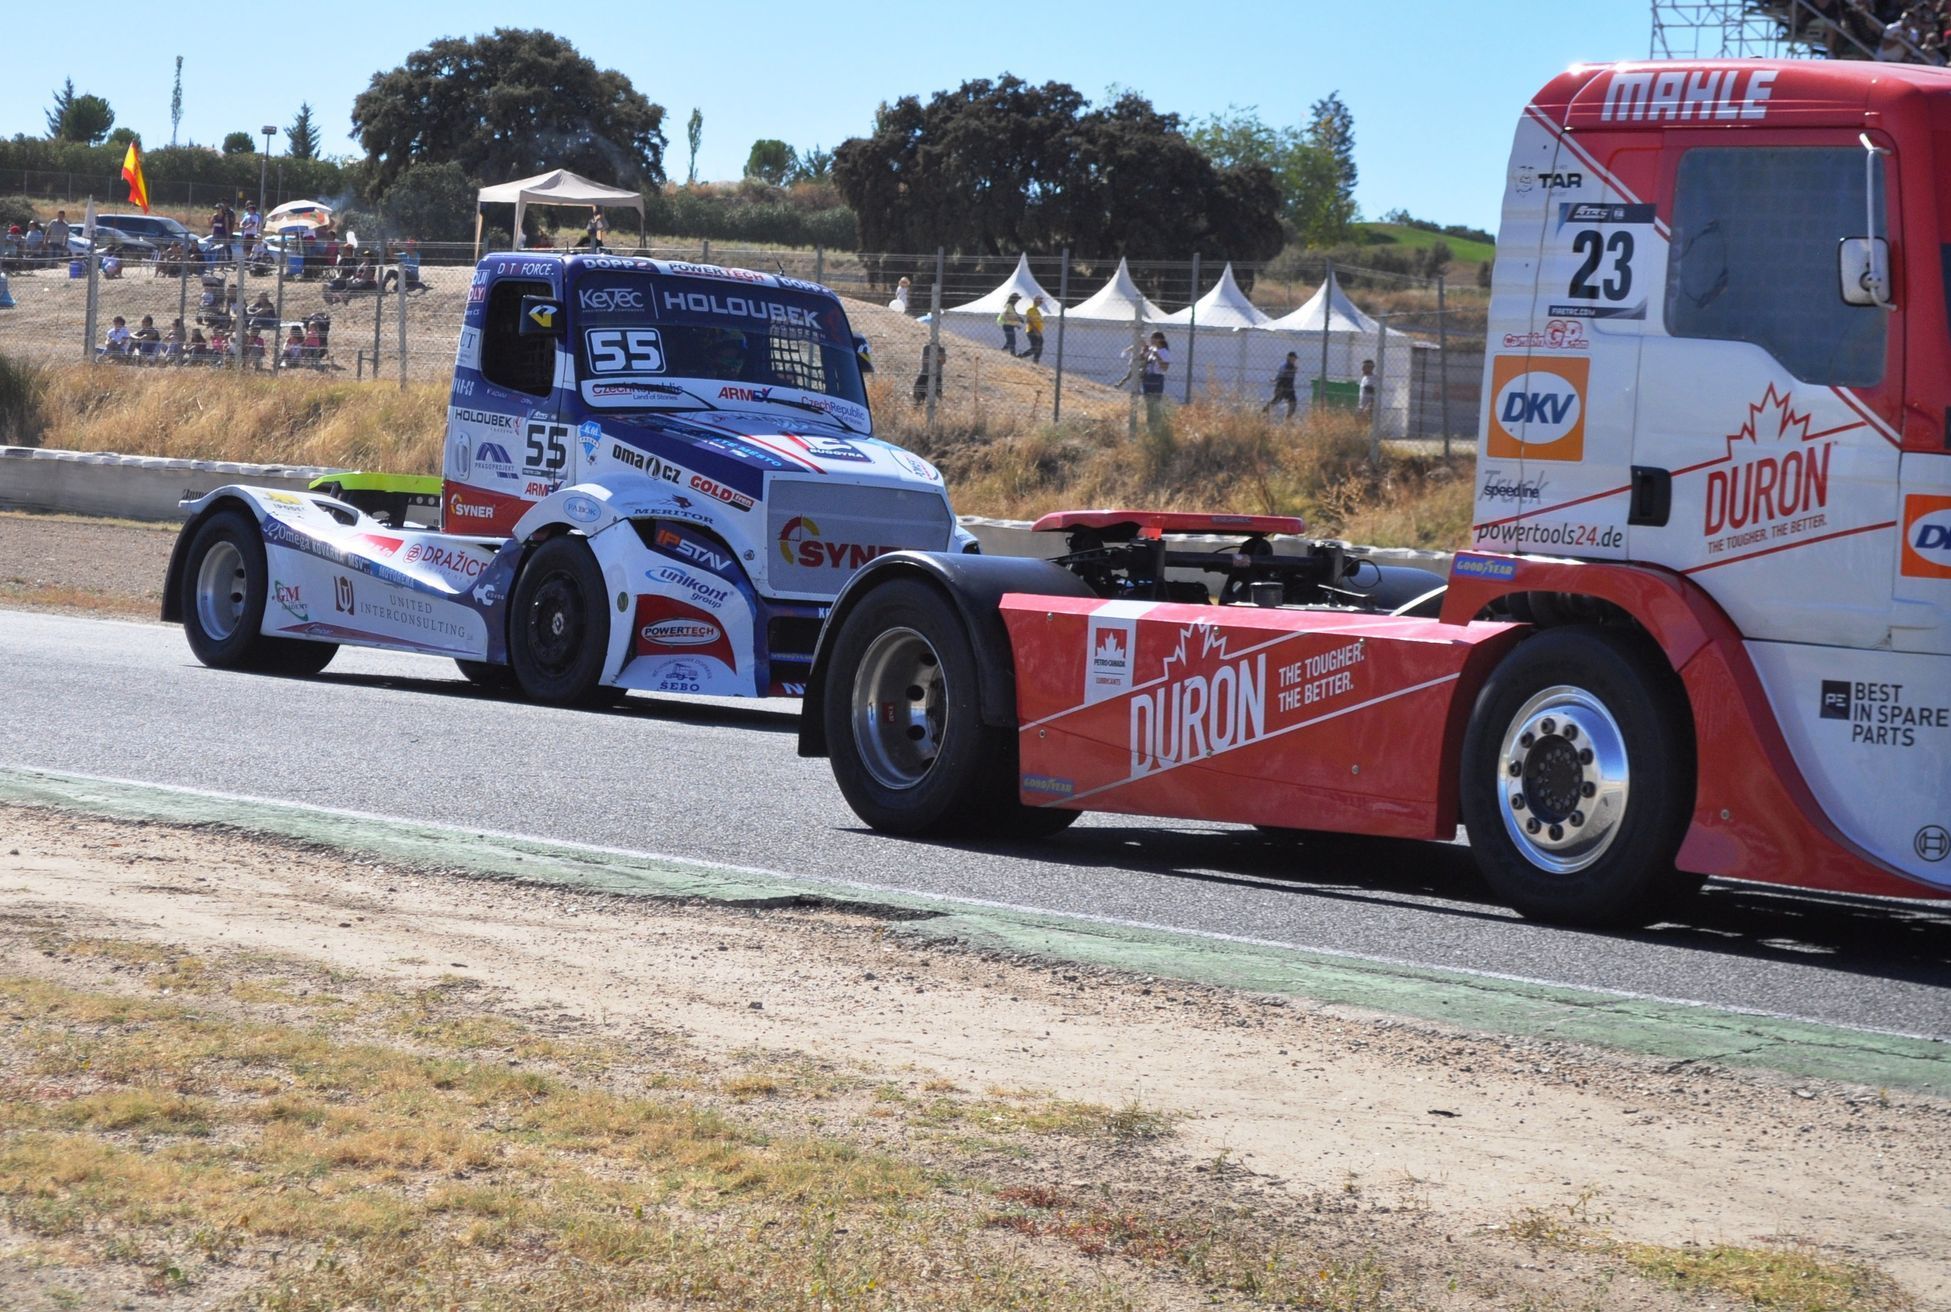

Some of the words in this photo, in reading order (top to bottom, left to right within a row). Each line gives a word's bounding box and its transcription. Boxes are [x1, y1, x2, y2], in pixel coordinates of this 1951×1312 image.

[1601, 70, 1779, 121] MAHLE
[1538, 173, 1582, 189] TAR
[1568, 229, 1635, 302] 23
[664, 290, 822, 330] HOLOUBEK
[591, 331, 661, 371] 55
[455, 408, 512, 428] HOLOUBEK
[1501, 391, 1576, 425] DKV
[525, 424, 569, 470] 55
[662, 465, 682, 485] CZ
[1704, 442, 1832, 537] DURON
[455, 502, 494, 519] SYNER
[634, 508, 715, 525] MERITOR
[278, 525, 310, 550] Omega
[1477, 523, 1623, 548] powertools24.de
[1708, 540, 1724, 554] THE
[1727, 528, 1768, 550] TOUGHER.
[1771, 525, 1789, 539] THE
[1790, 513, 1827, 534] BETTER.
[656, 528, 732, 571] IPSTAV
[798, 539, 928, 569] SYN
[1456, 560, 1513, 576] GOODYEAR
[660, 568, 729, 602] unikont
[389, 594, 433, 615] UNITED
[690, 592, 722, 609] group
[359, 601, 466, 639] INTERCONSULTING
[644, 626, 715, 636] POWERTECH
[1278, 663, 1302, 688] THE
[1304, 641, 1366, 680] TOUGHER.
[659, 680, 700, 692] ŠEBO
[1278, 688, 1302, 713] THE
[1304, 674, 1354, 705] BETTER.
[1855, 682, 1903, 703] BEST
[1130, 652, 1267, 780] DURON
[1853, 703, 1873, 722] IN
[1878, 704, 1950, 727] SPARE
[1852, 724, 1915, 747] PARTS
[1023, 777, 1073, 793] GOODYEAR
